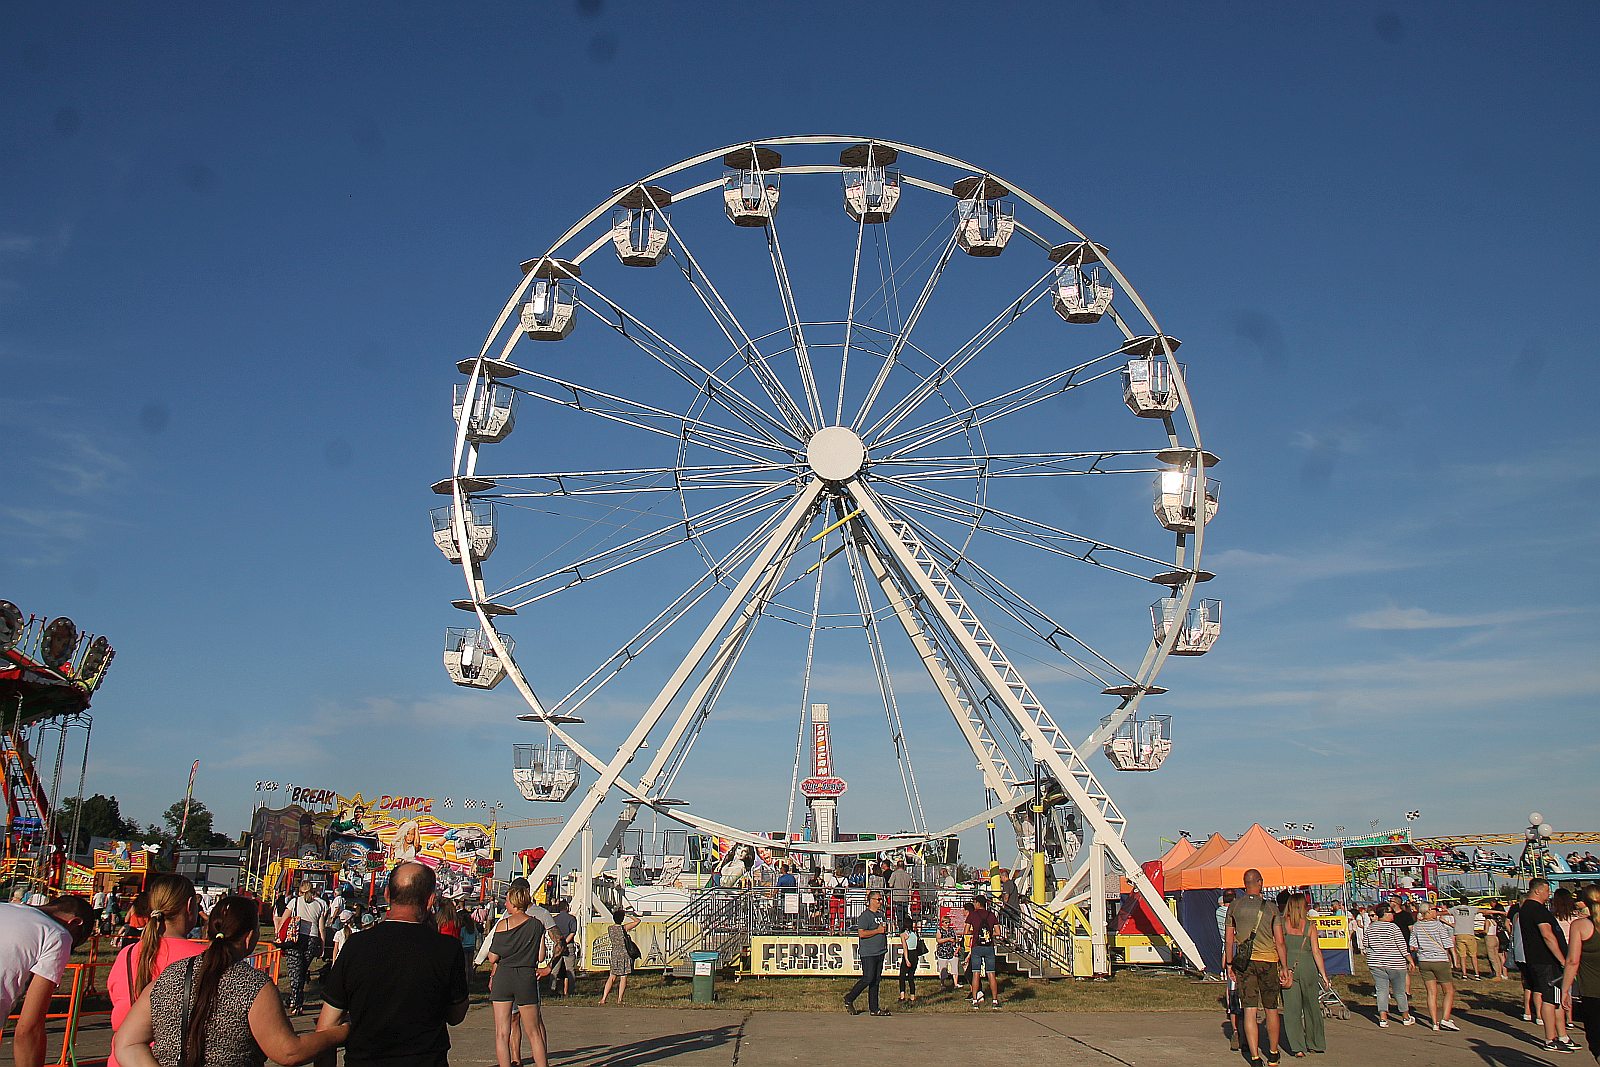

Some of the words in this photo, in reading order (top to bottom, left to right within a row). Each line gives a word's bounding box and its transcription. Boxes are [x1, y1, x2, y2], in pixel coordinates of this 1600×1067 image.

[817, 724, 825, 742] TOP
[817, 745, 828, 775] SCAN
[291, 786, 336, 804] BREAK
[379, 795, 435, 812] DANCE
[762, 943, 843, 971] FERRIS
